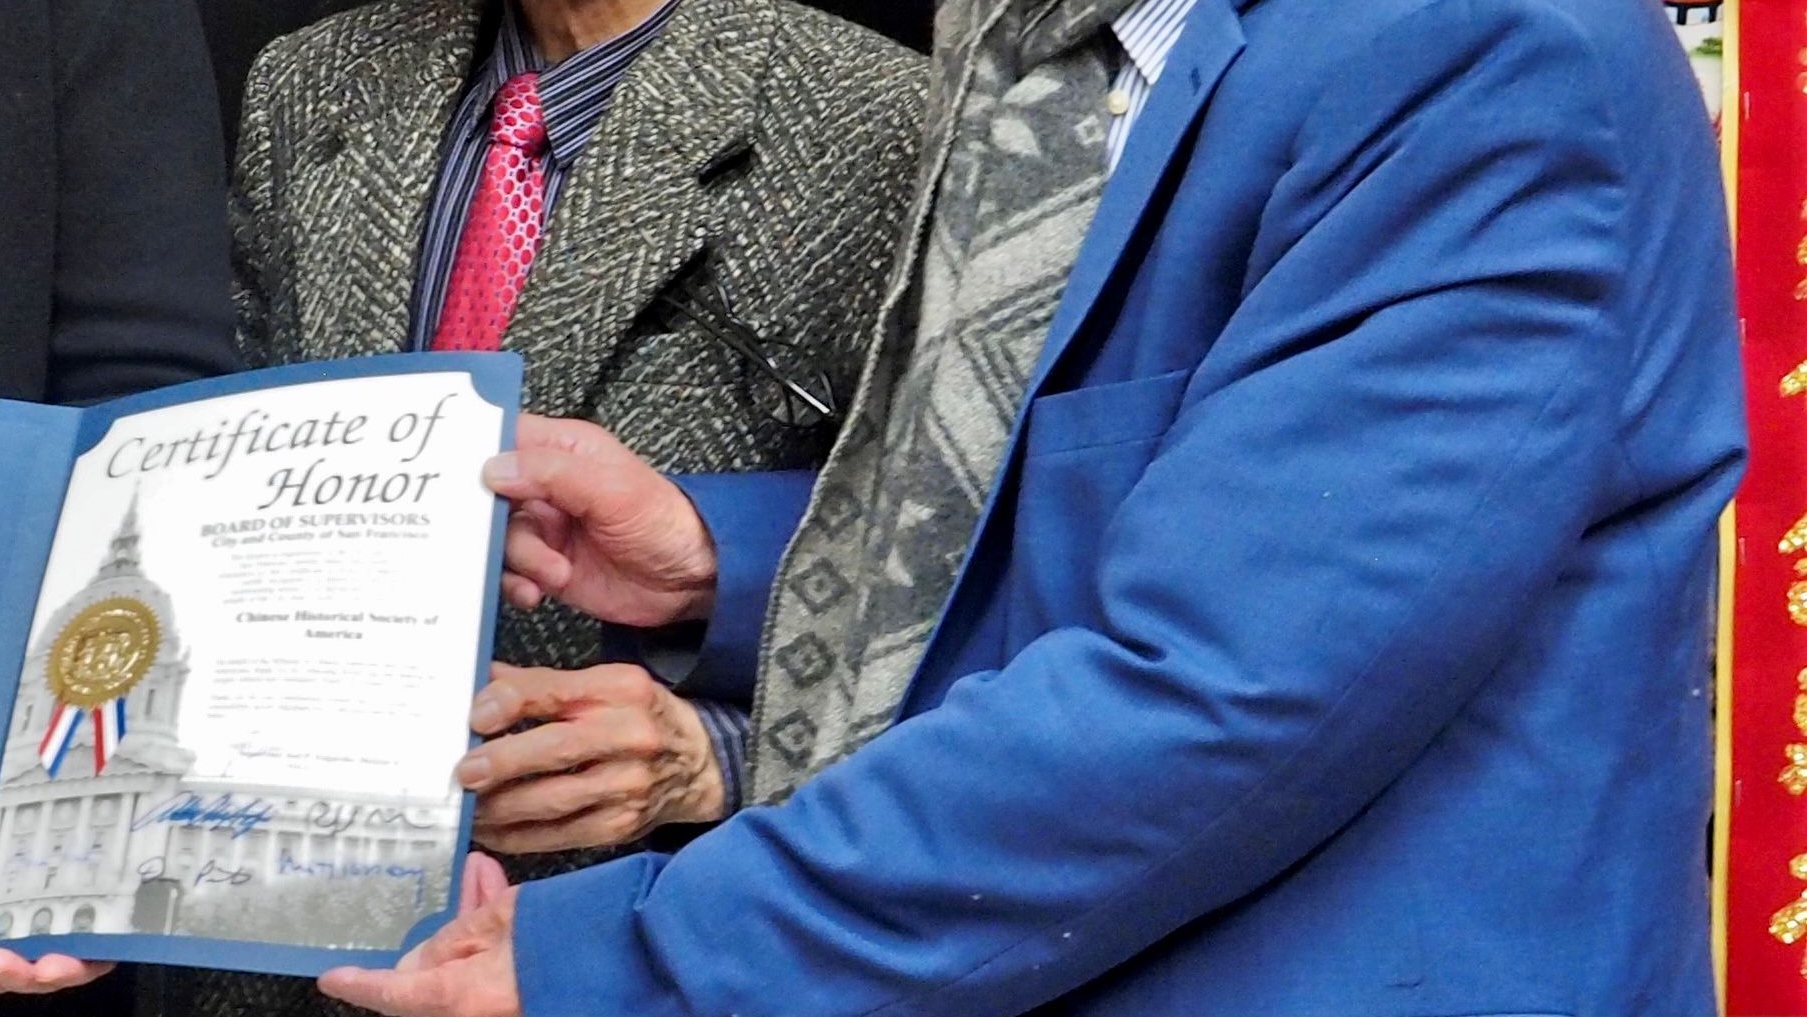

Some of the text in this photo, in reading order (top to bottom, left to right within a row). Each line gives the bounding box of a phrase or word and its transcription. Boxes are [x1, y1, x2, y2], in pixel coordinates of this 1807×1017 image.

[105, 392, 458, 481] Certificate of
[256, 458, 441, 511] Honor
[201, 512, 432, 538] BOARD OF SUPERVISORS
[211, 535, 238, 549] City
[241, 533, 266, 545] and
[268, 531, 315, 543] County
[319, 530, 334, 540] of
[337, 529, 362, 539] San
[236, 609, 440, 626] Chinese Historical Society of
[304, 628, 363, 640] America
